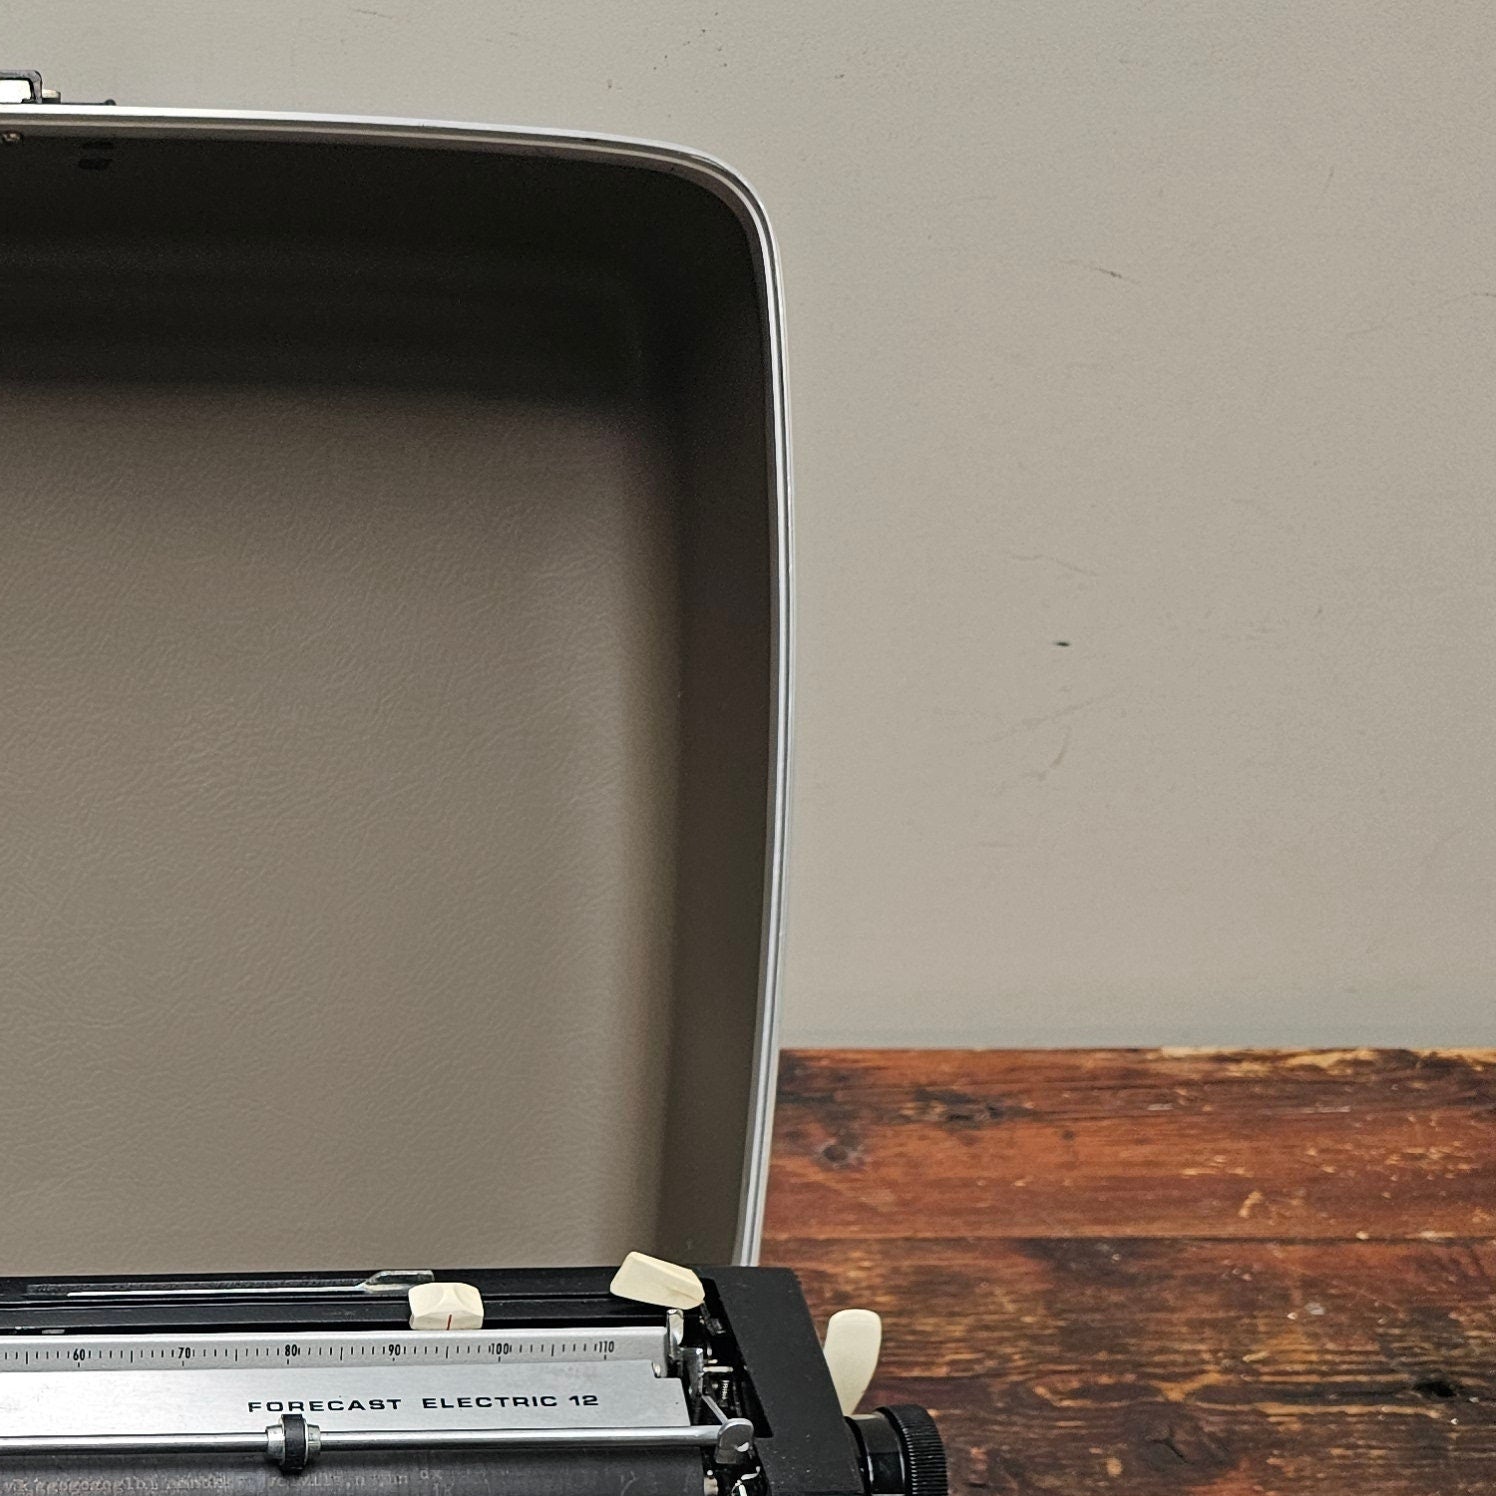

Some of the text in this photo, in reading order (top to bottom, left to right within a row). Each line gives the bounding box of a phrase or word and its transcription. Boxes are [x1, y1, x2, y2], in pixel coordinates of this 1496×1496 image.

[73, 1349, 85, 1361] 60
[178, 1347, 191, 1359] 70
[285, 1345, 297, 1356] 80
[389, 1344, 400, 1356] 90
[491, 1343, 509, 1355] 100
[598, 1341, 614, 1353] 110
[248, 1395, 599, 1413] FORECAST ELECTRIC 12
